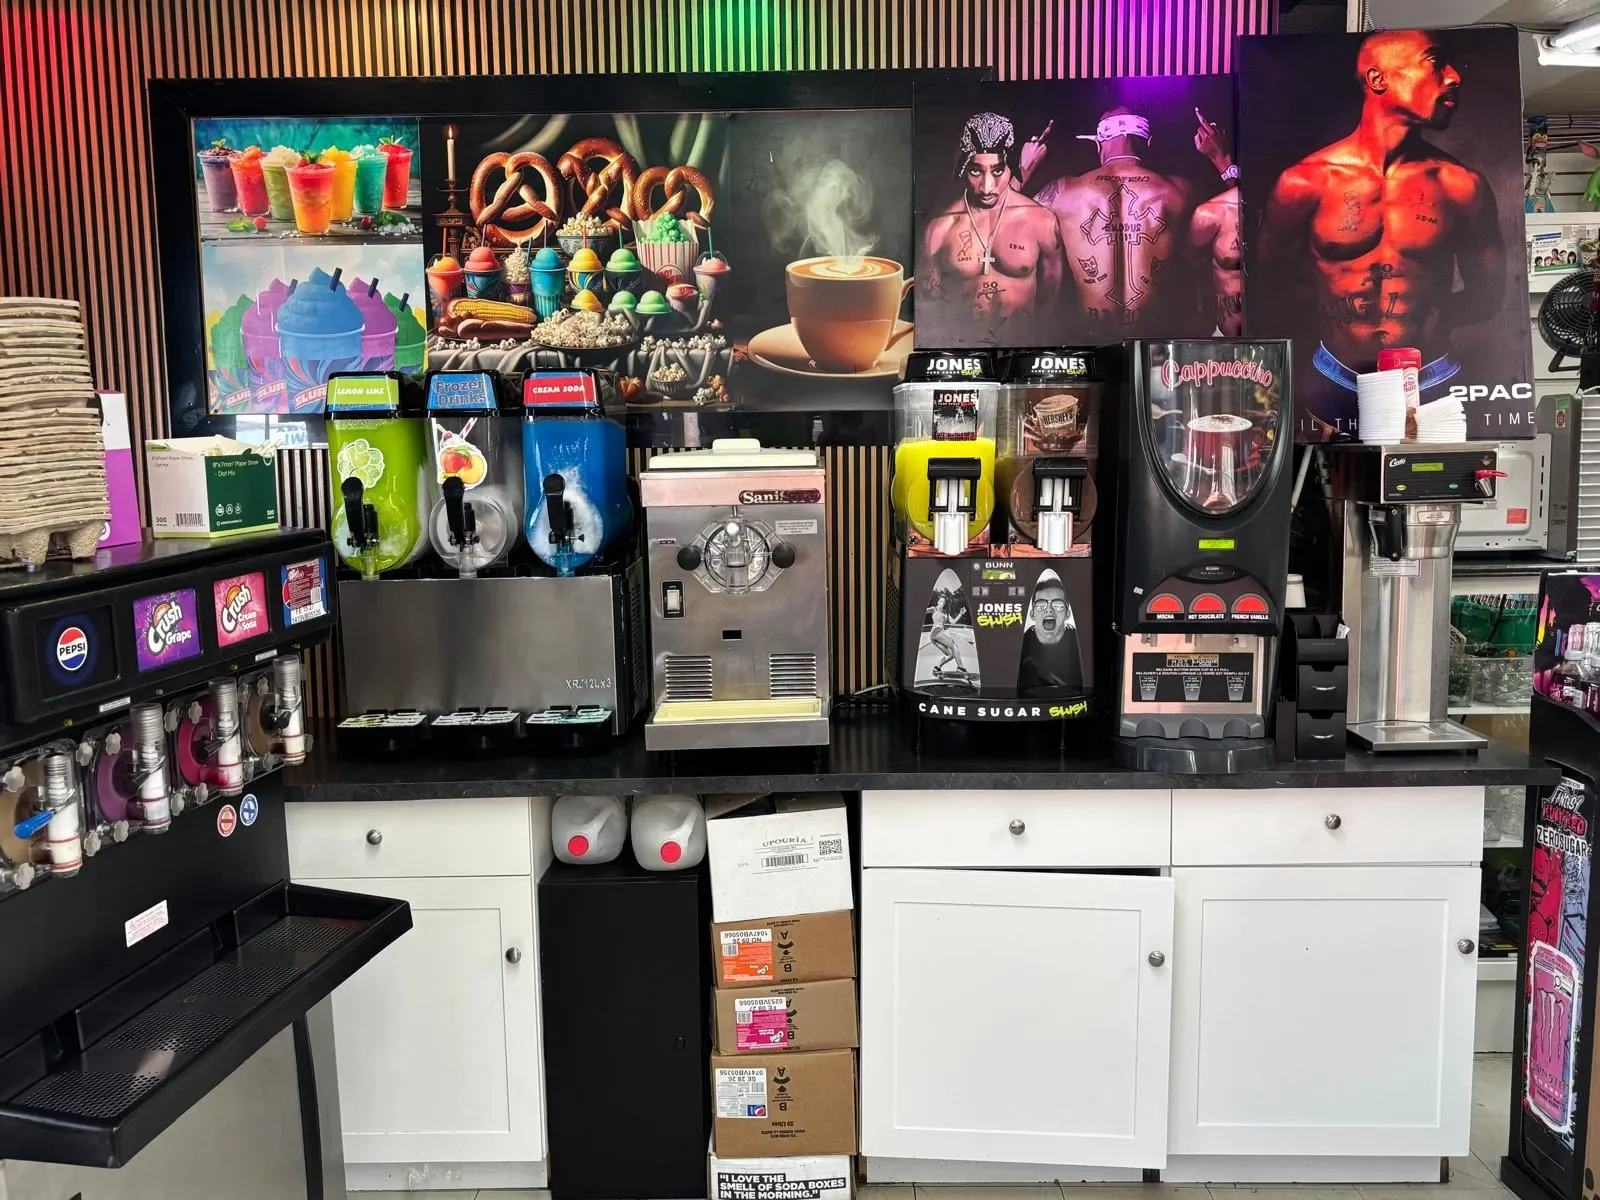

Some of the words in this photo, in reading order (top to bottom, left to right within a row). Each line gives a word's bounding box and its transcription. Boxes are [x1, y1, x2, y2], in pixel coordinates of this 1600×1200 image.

[927, 358, 981, 370] JONES
[1031, 357, 1086, 369] JONES
[1161, 360, 1273, 387] Cappuccino
[365, 387, 385, 395] LIME
[532, 386, 561, 395] CREAM
[562, 385, 586, 394] SODA
[1449, 383, 1532, 401] 2PAC
[438, 391, 486, 407] Drinks
[938, 393, 977, 403] JONES
[1484, 411, 1535, 426] TIME
[222, 583, 251, 632] Crush
[977, 603, 1023, 613] JONES
[237, 611, 257, 623] Cream
[148, 601, 183, 653] Crush
[242, 620, 257, 631] Soda
[165, 629, 192, 645] Grape
[59, 642, 86, 656] PEPSI
[918, 703, 966, 716] CANE
[977, 706, 1041, 717] SUGAR
[1049, 701, 1088, 718] SLUSH
[780, 931, 788, 940] A
[784, 964, 792, 972] B
[788, 1031, 795, 1040] B
[777, 1067, 786, 1076] A
[779, 1103, 787, 1111] B
[731, 1175, 761, 1183] LOVE
[762, 1174, 784, 1182] THE
[720, 1182, 756, 1191] SMELL
[757, 1183, 773, 1192] OF
[775, 1181, 806, 1191] SODA
[808, 1179, 845, 1190] BOXES
[720, 1191, 733, 1199] IN
[734, 1191, 757, 1200] THE
